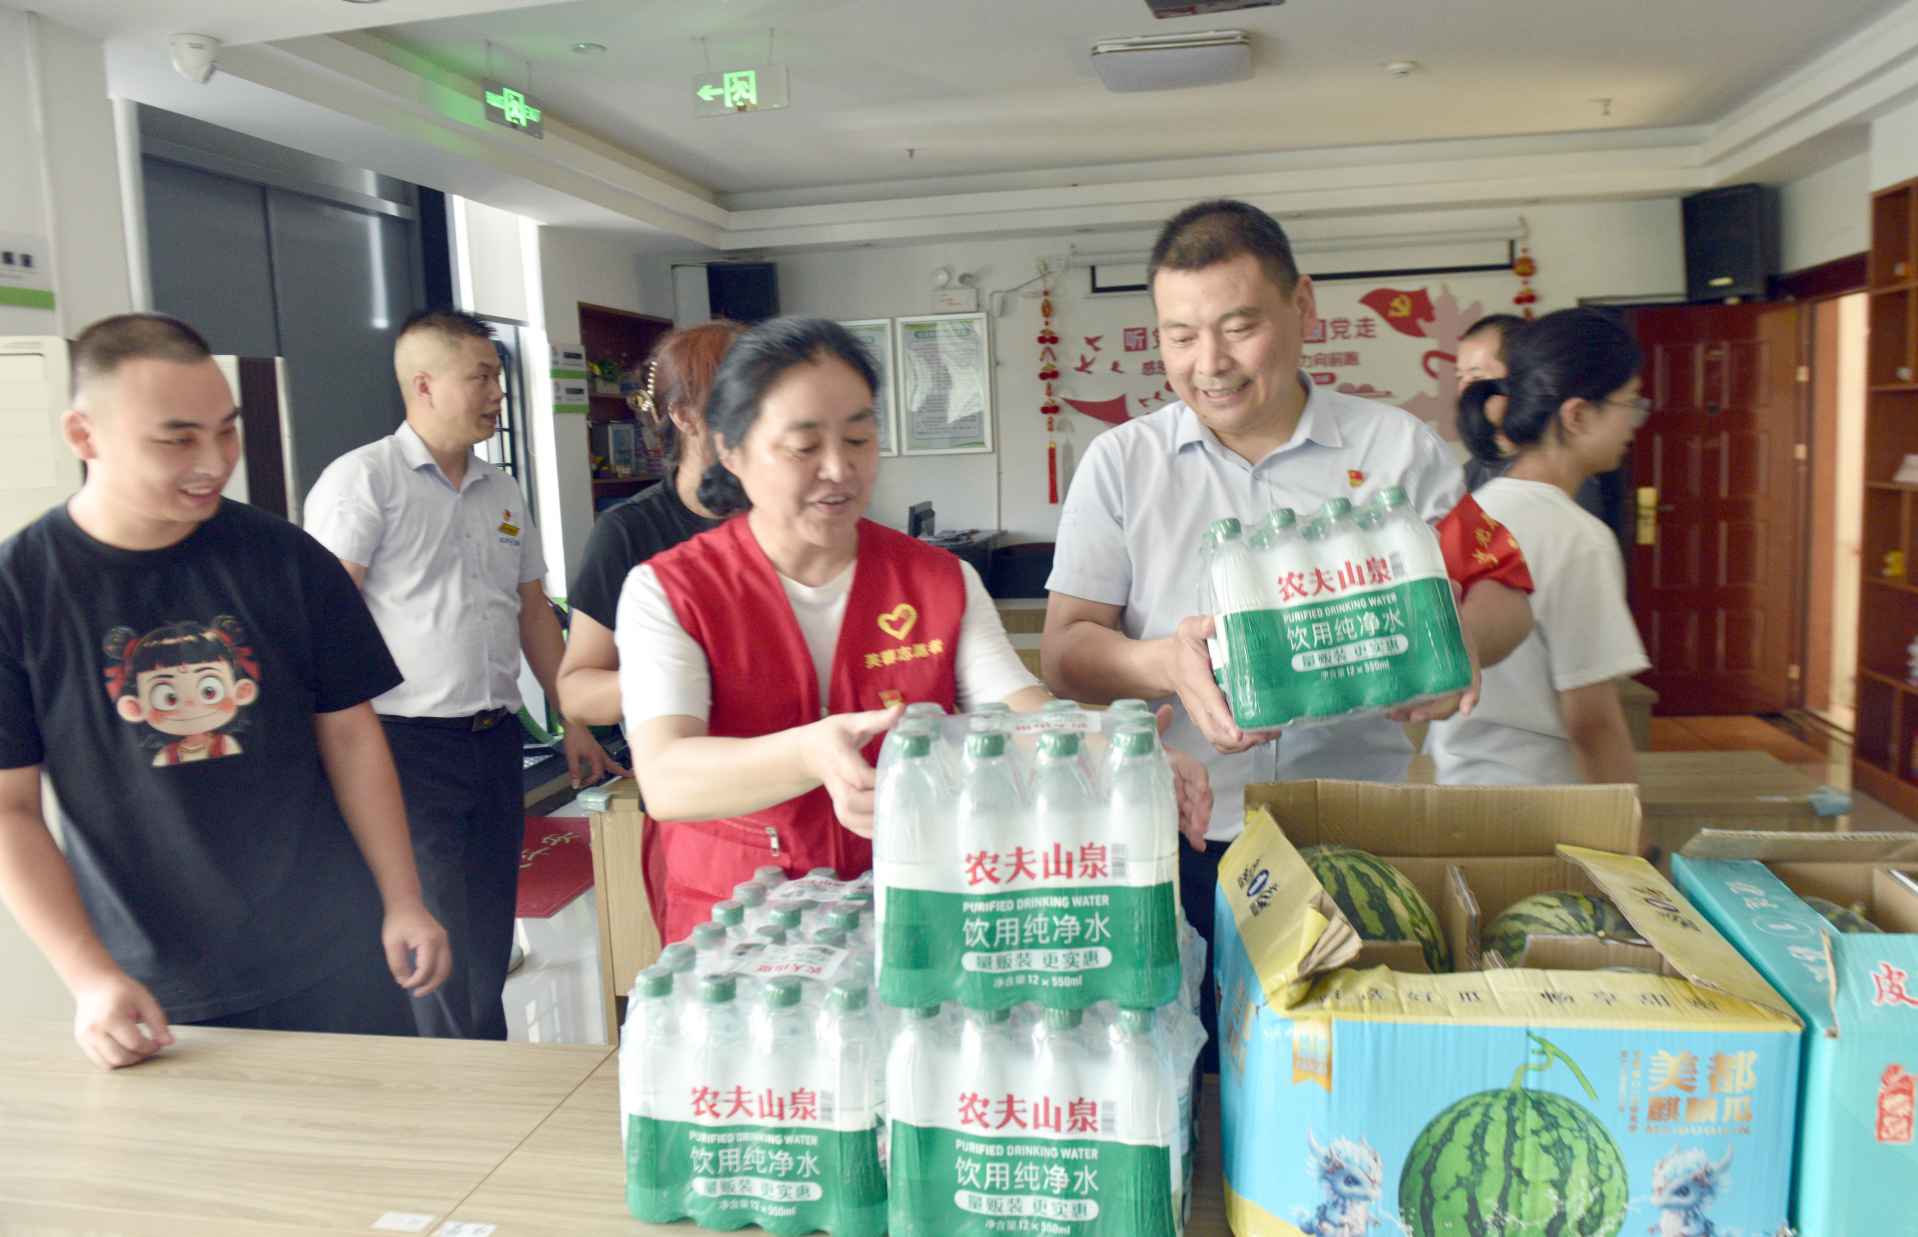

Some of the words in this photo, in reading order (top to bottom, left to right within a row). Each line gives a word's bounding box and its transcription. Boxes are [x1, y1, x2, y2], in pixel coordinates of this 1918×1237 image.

[1278, 557, 1392, 602] 农夫山泉
[1286, 607, 1405, 652] 饮用纯净水
[965, 842, 1108, 886] 农夫山泉
[962, 900, 1014, 912] PURIFIED
[1017, 896, 1069, 909] DRINKING
[1072, 895, 1109, 906] WATER
[962, 912, 1111, 948] 饮用纯净水
[1648, 1050, 1757, 1092] 美都
[691, 1085, 817, 1120] 农夫山泉
[958, 1092, 1098, 1132] 农夫山泉
[784, 1134, 818, 1146] WATER
[955, 1139, 1003, 1156] PURIFIED
[1007, 1144, 1057, 1158] DRINKING
[1060, 1148, 1098, 1160] WATER
[690, 1145, 820, 1177] 饮用纯净水
[955, 1156, 1099, 1195] 饮用纯净水
